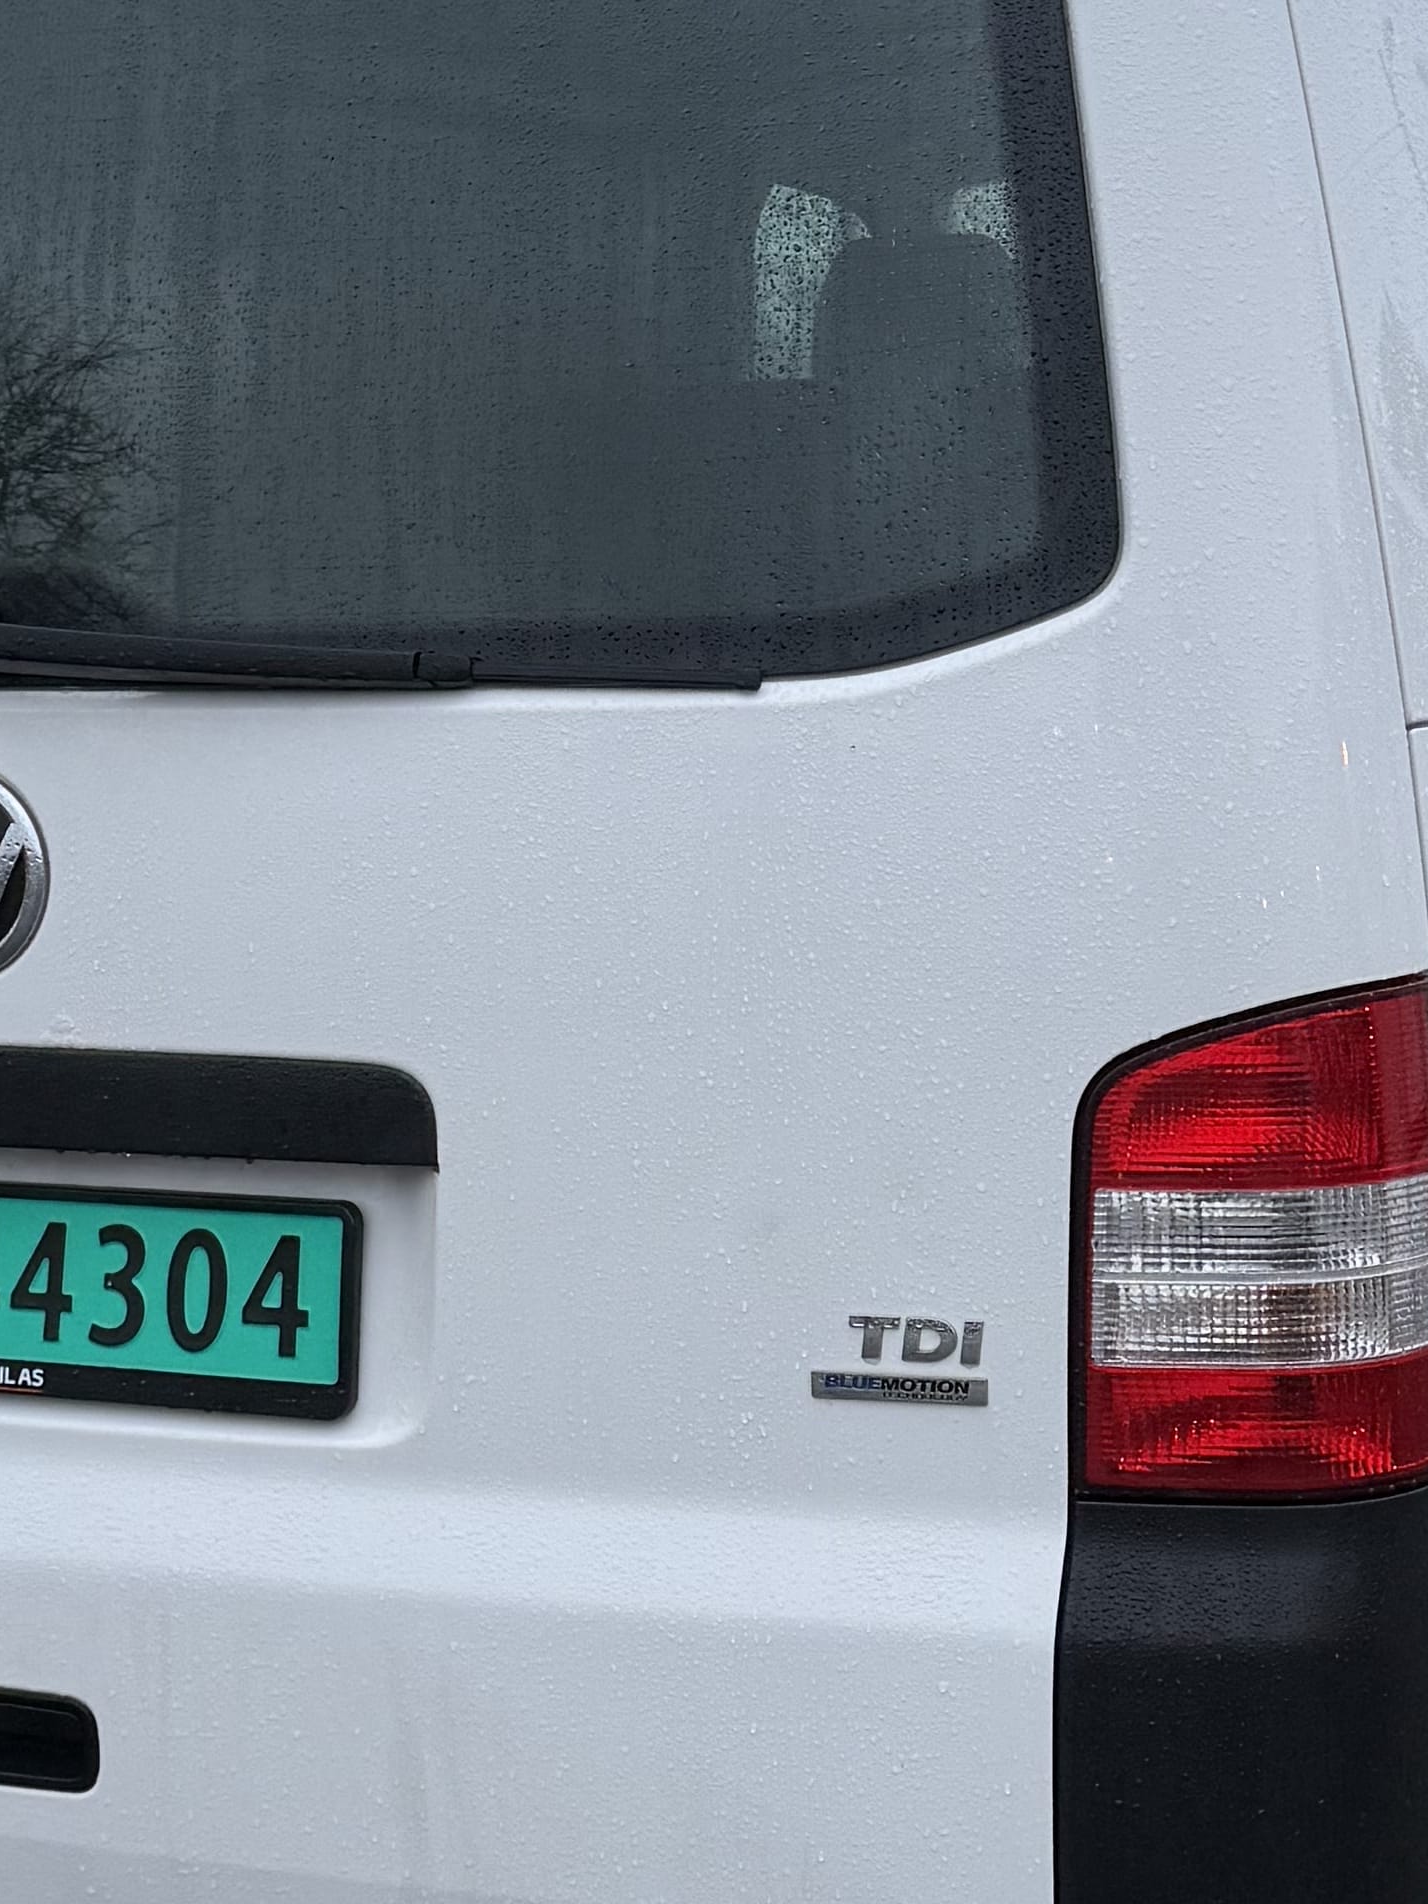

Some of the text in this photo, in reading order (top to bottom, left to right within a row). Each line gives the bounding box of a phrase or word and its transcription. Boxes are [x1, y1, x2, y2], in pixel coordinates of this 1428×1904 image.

[848, 1315, 985, 1367] TDI
[17, 1368, 45, 1388] AS
[824, 1372, 970, 1395] BLUEMOTION
